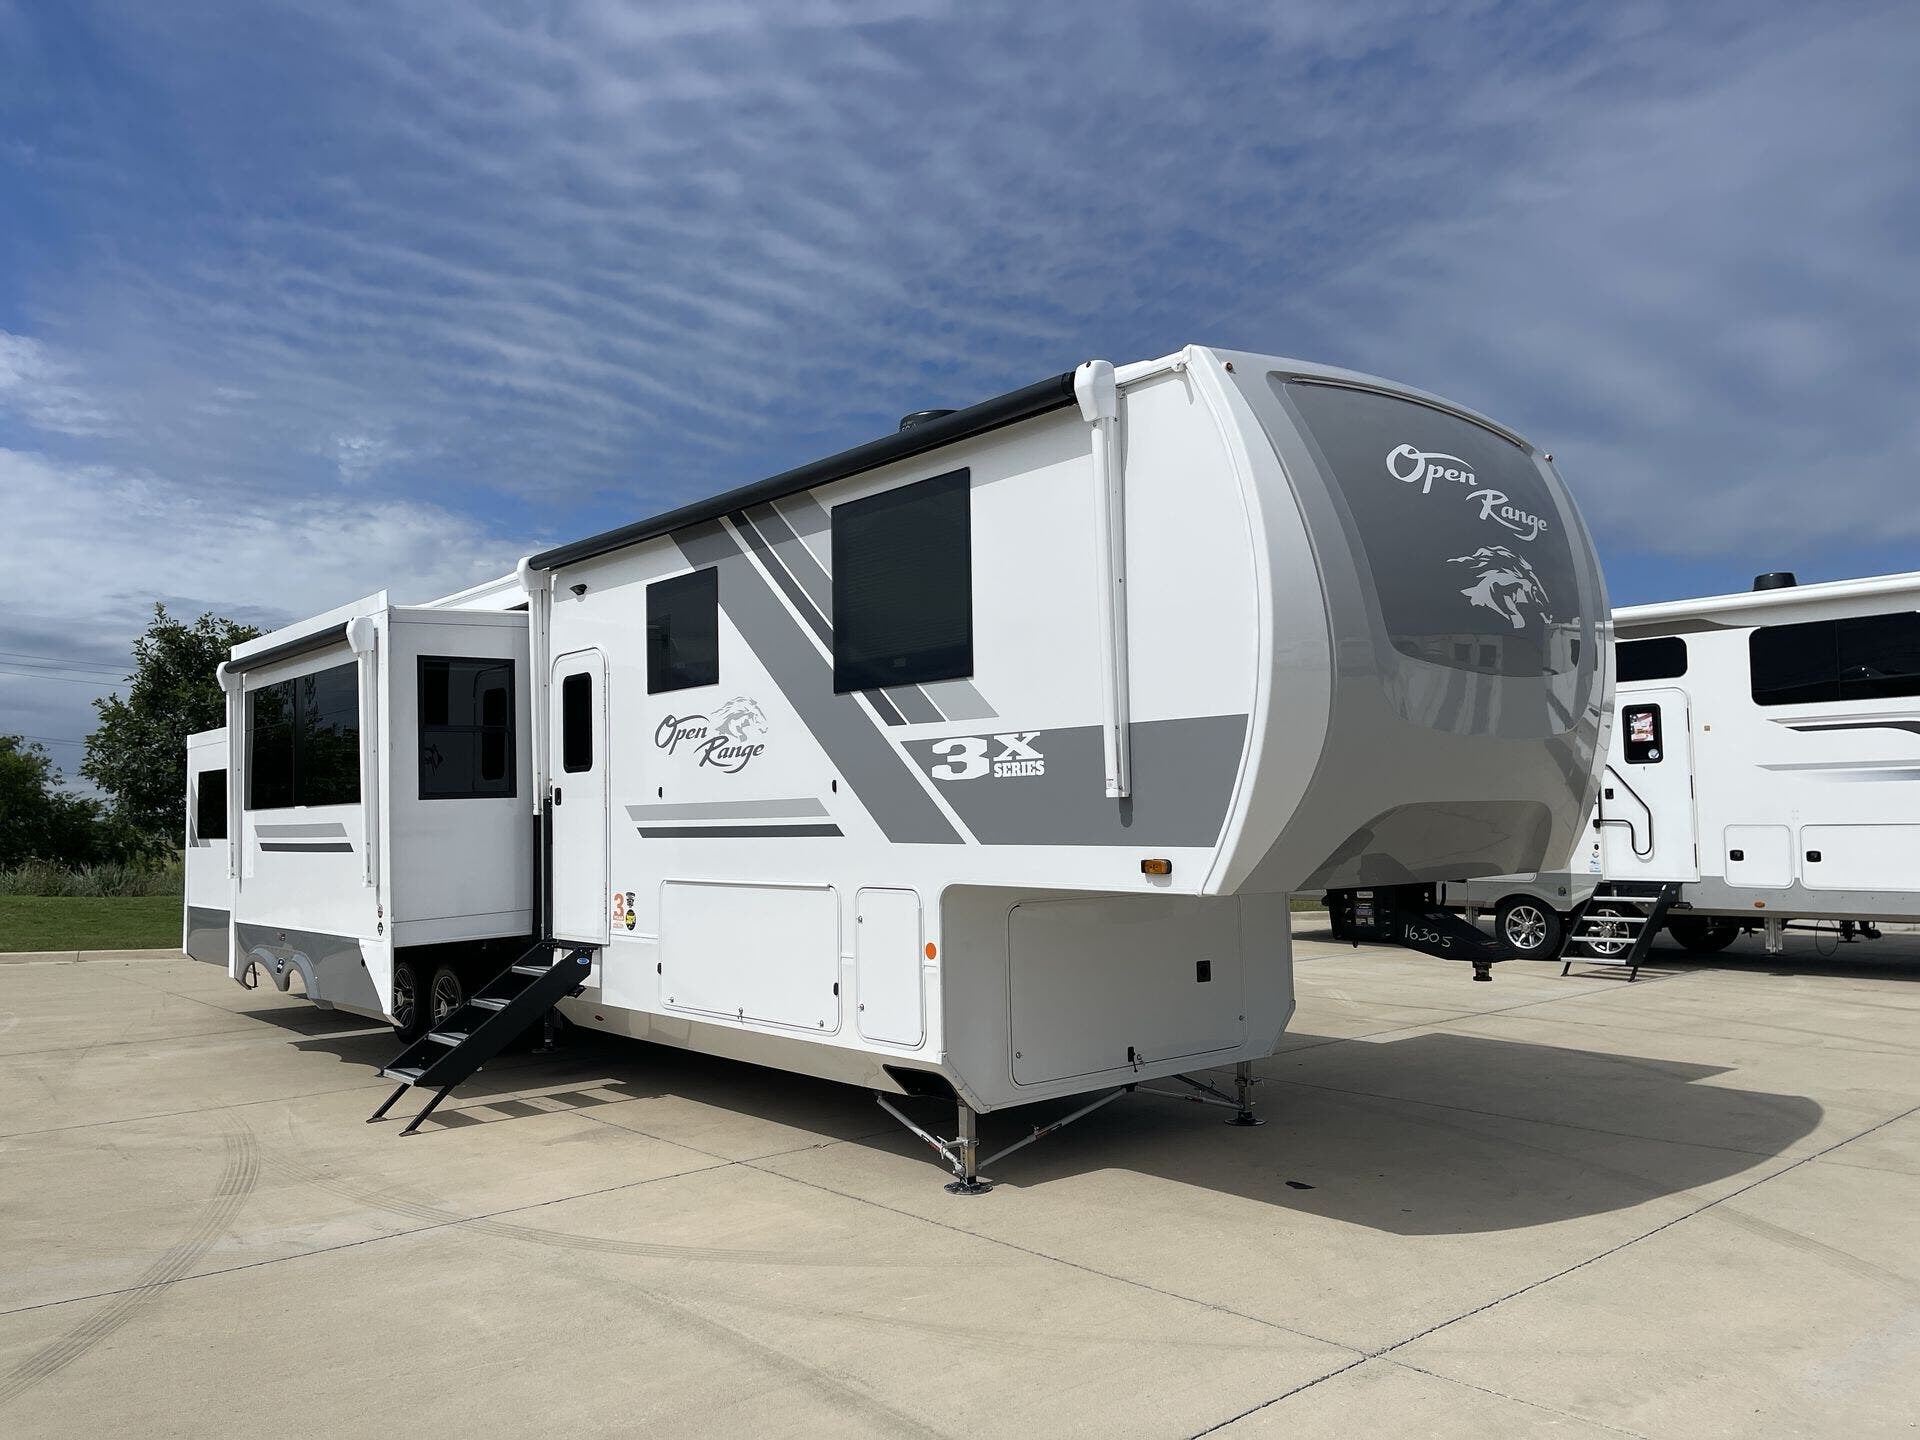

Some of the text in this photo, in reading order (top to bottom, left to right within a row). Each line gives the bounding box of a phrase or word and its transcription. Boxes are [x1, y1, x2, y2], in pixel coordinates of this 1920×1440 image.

[1386, 443, 1478, 494] Open
[1465, 489, 1548, 541] Range
[655, 714, 710, 755] Open
[693, 735, 765, 774] Range
[993, 760, 1045, 778] SERIES
[613, 893, 624, 916] 3
[1404, 923, 1453, 948] 16305
